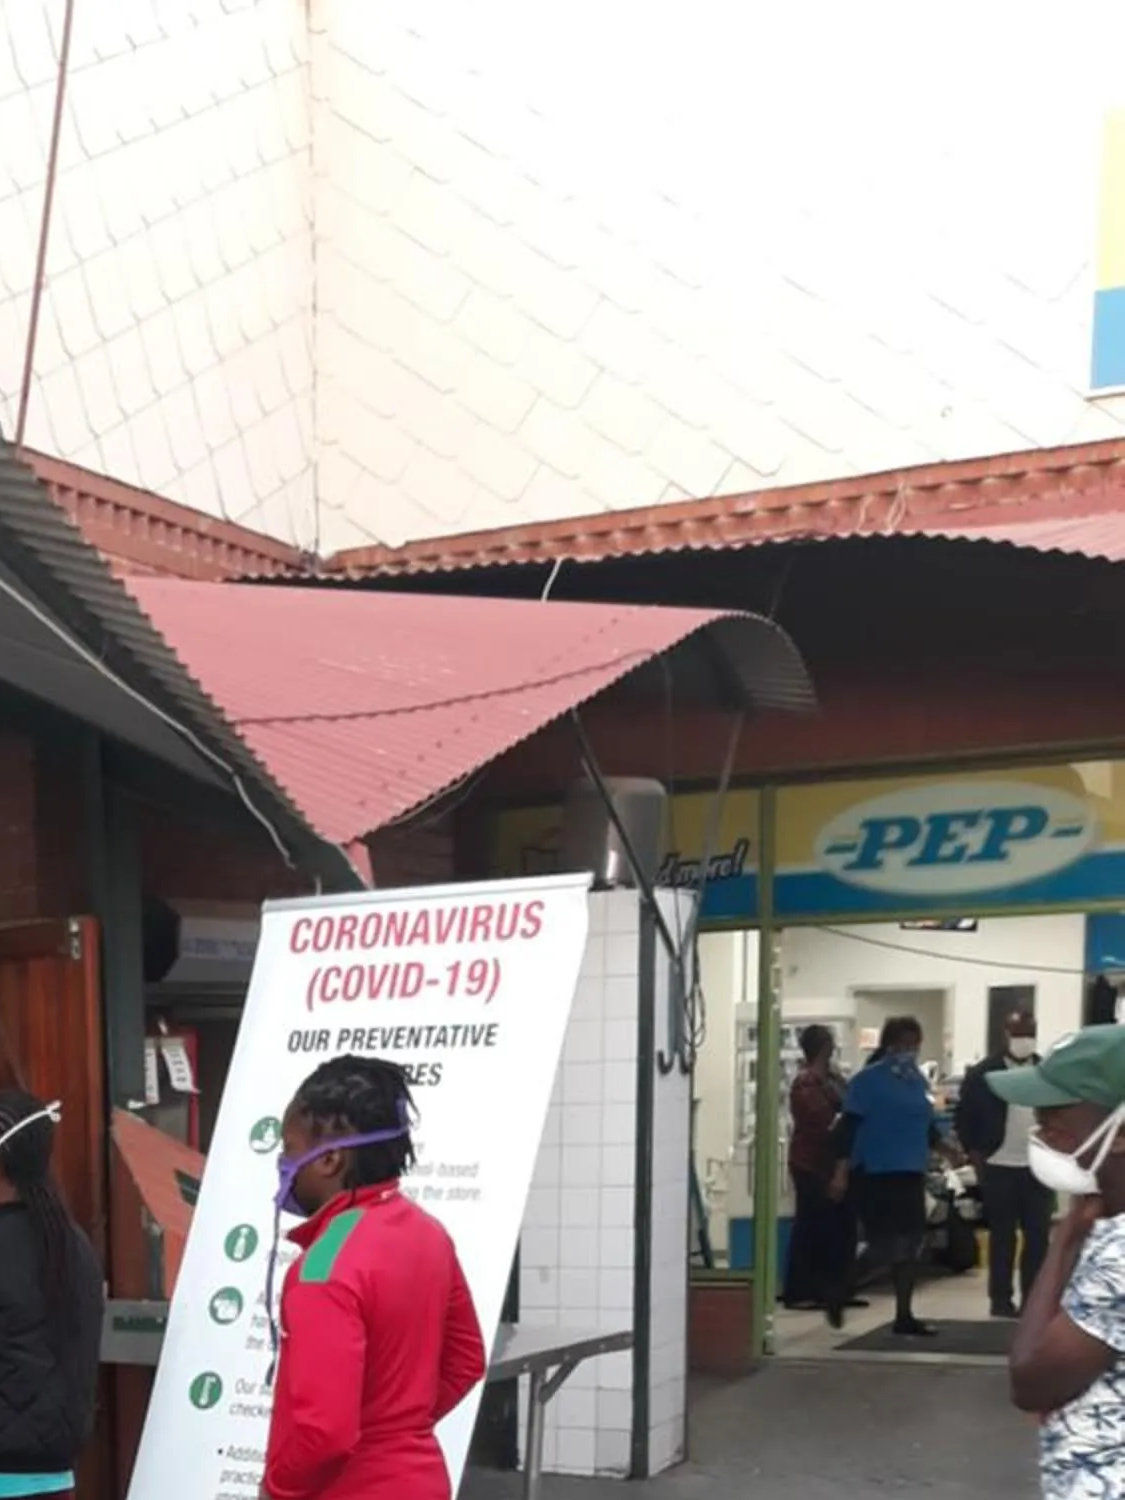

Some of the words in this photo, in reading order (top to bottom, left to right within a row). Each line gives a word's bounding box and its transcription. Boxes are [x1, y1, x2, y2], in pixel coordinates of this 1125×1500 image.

[289, 899, 546, 954] CORONAVIRUS
[305, 957, 503, 1012] (COVID-19)
[287, 1028, 330, 1054] OUR
[336, 1022, 500, 1051] PREVENTATIVE
[235, 1377, 258, 1395] Our
